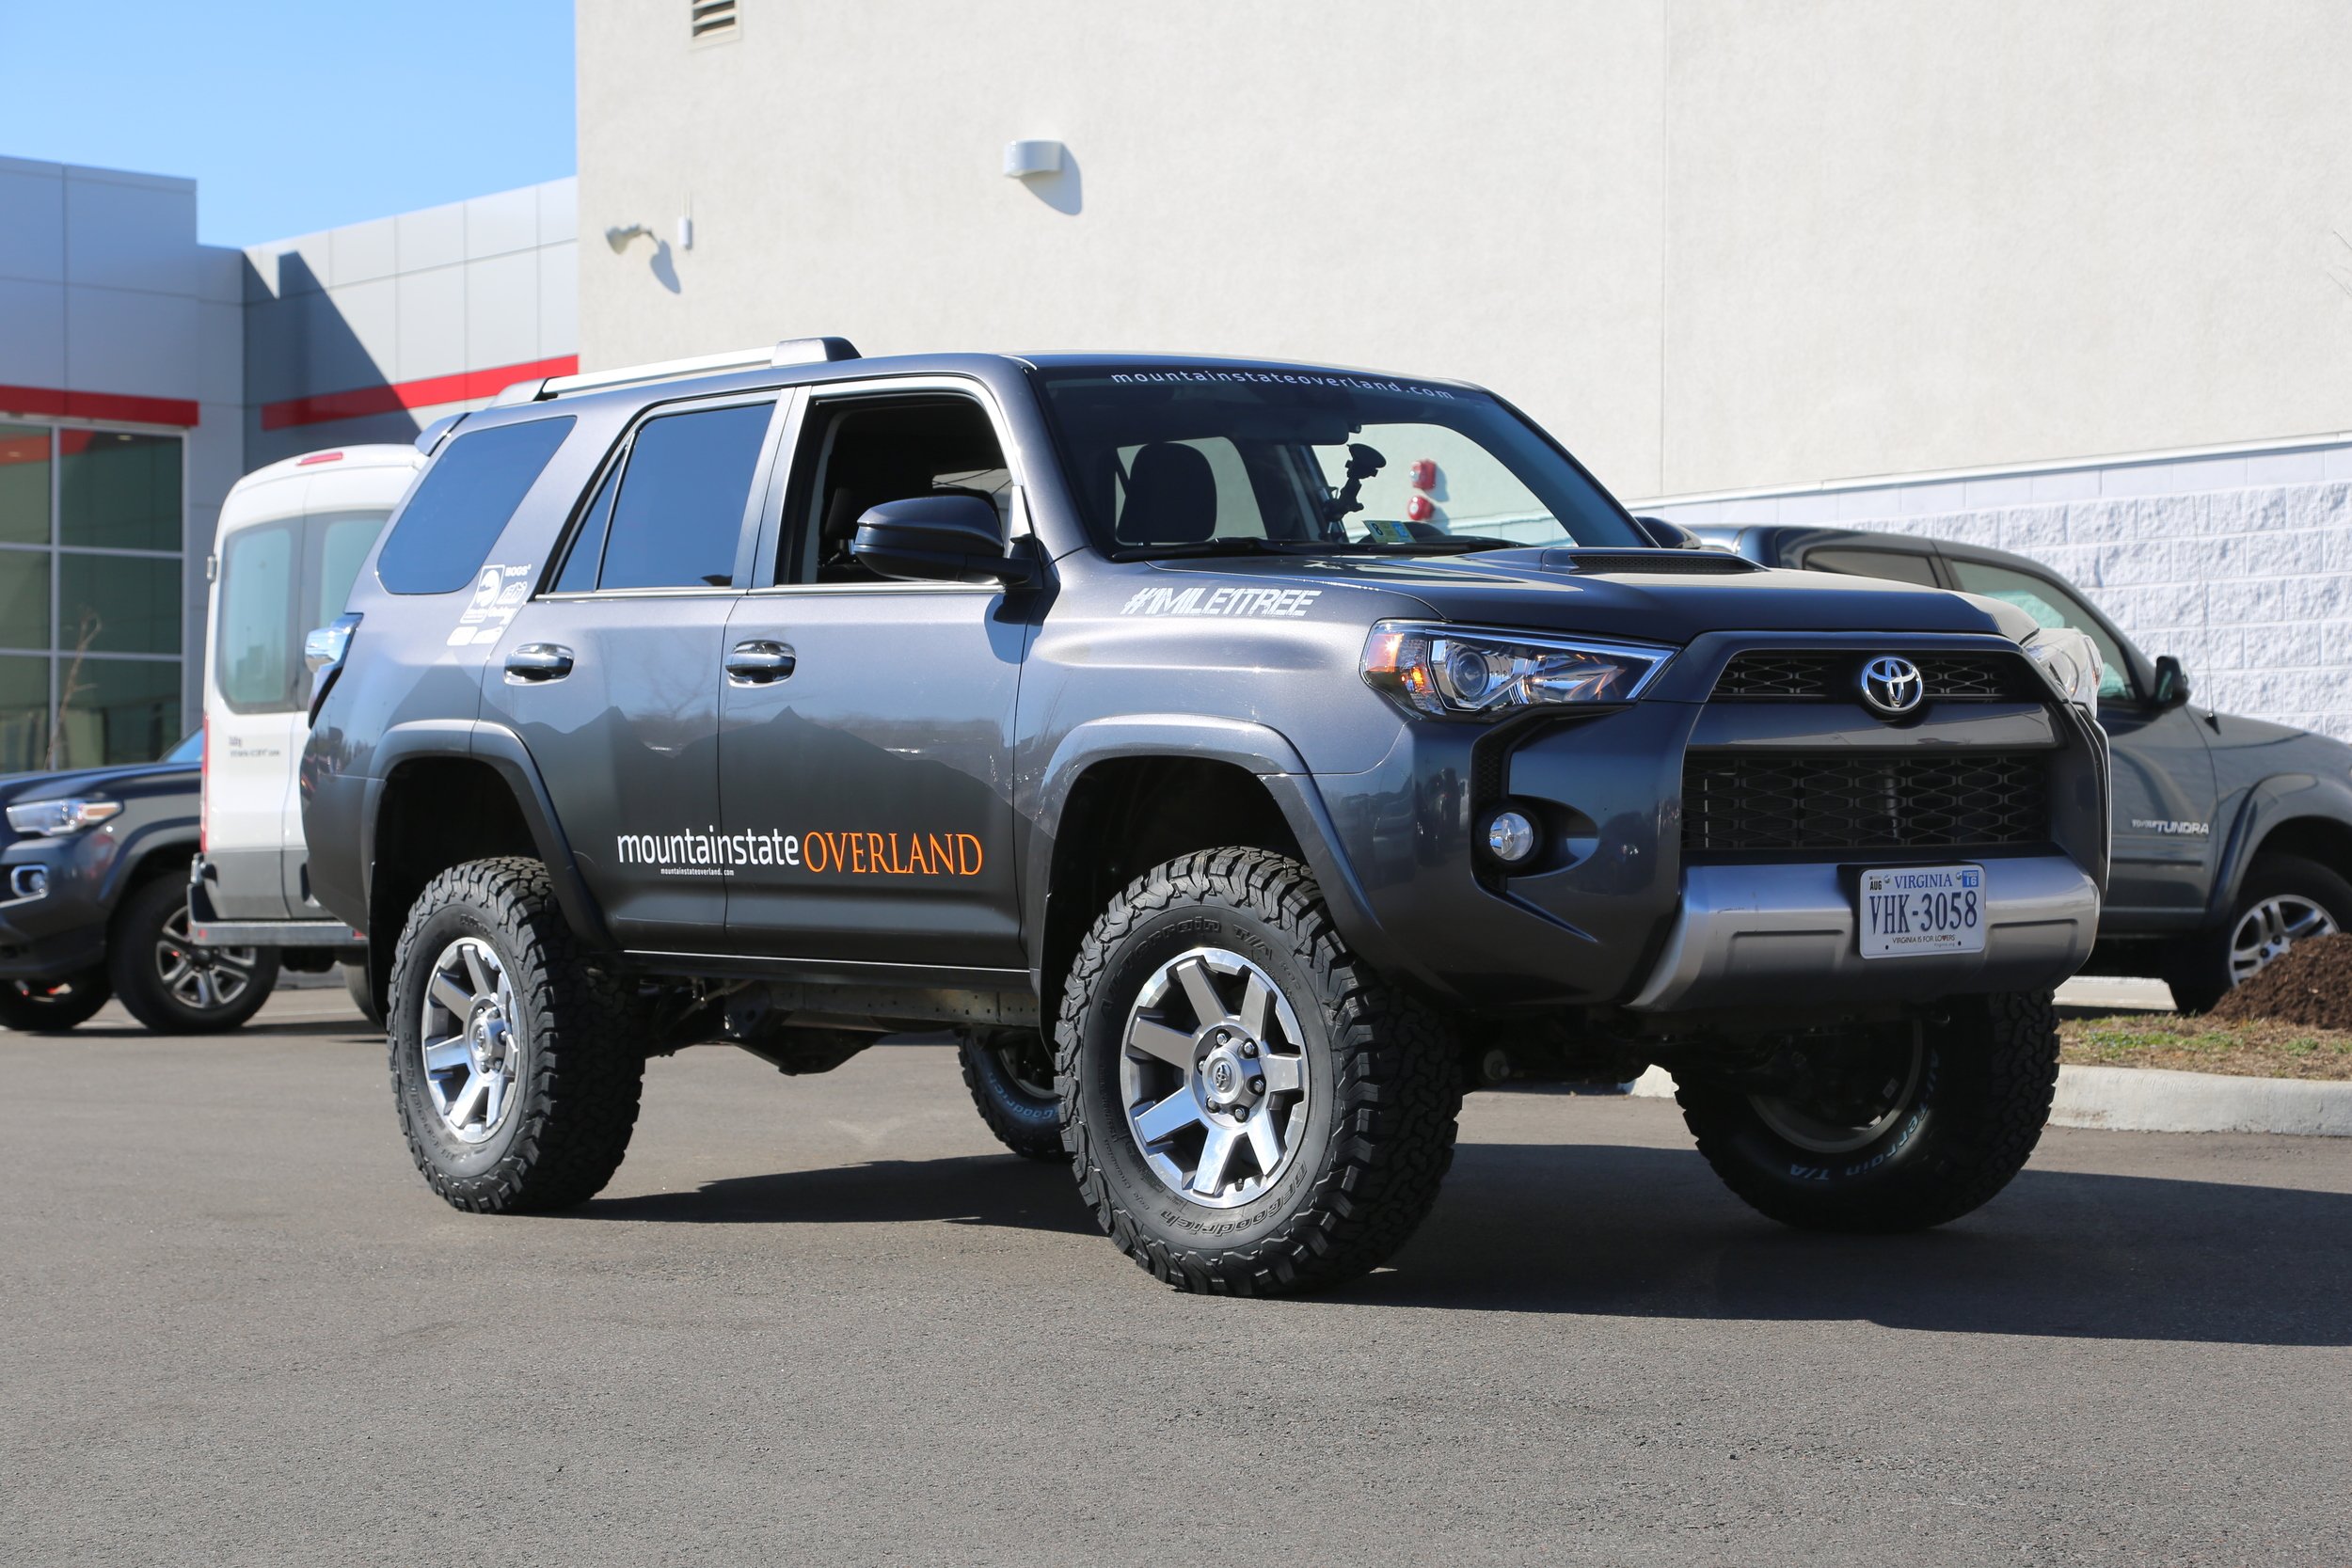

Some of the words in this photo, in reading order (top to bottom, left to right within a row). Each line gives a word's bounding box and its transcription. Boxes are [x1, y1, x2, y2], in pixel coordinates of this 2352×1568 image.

[1111, 370, 1454, 400] mountainstateoverland.com
[1120, 588, 1322, 616] #1MILE1TREE
[2156, 820, 2209, 834] TUNDRA
[617, 825, 799, 866] mountainstate
[803, 832, 983, 876] OVERLAND
[1869, 880, 1882, 891] AUG
[1895, 874, 1952, 889] VIRGINIA
[1966, 877, 1977, 886] 16
[1869, 891, 1978, 934] VHK-3058
[1892, 936, 1916, 944] VIRGINIA
[1917, 935, 1922, 943] IS
[1161, 1160, 1307, 1237] BFGoodrich
